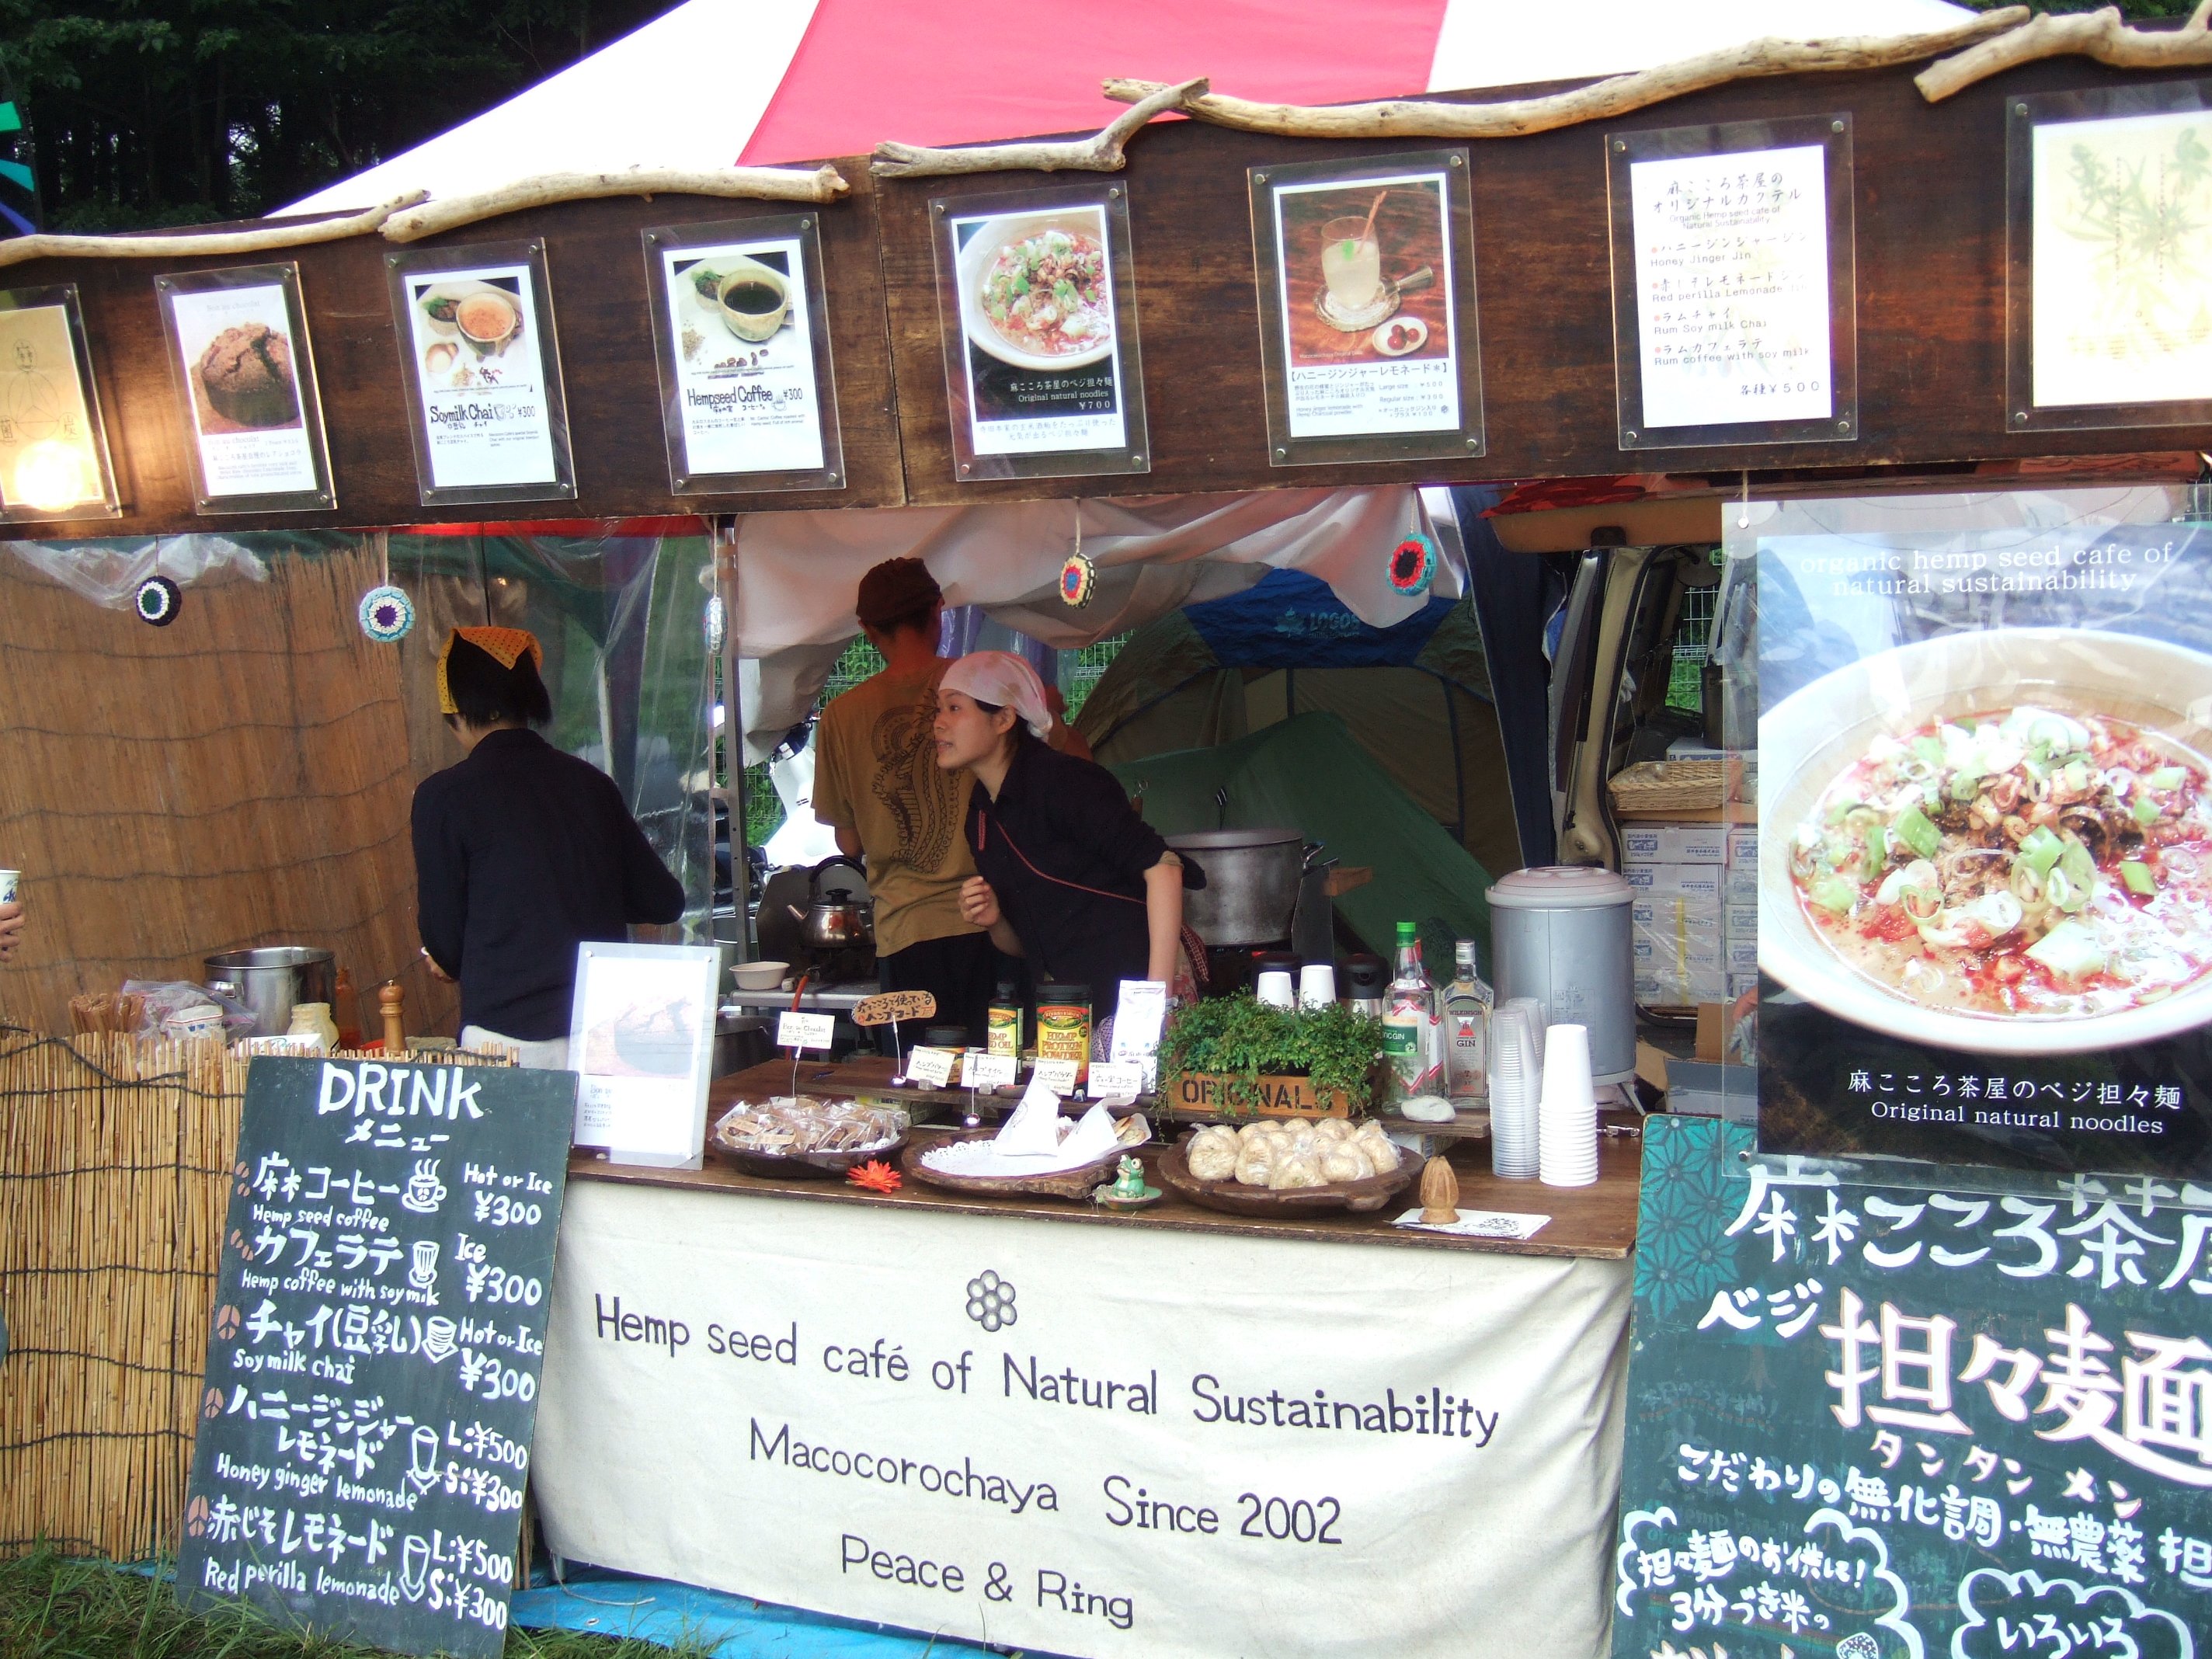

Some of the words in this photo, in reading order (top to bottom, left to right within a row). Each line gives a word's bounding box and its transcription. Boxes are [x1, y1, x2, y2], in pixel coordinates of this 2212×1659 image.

[1653, 189, 1802, 213] オリジナルカクテル
[1667, 172, 1783, 196] 麻こころ茶屋の
[1683, 220, 1713, 230] Natural
[1715, 216, 1771, 228] Sustainability
[1703, 210, 1727, 220] Hemp
[1729, 208, 1749, 217] seed
[1650, 257, 1684, 267] Honey
[1690, 254, 1726, 264] Jinger
[1732, 251, 1751, 260] Jin
[1652, 293, 1673, 302] Red
[1678, 289, 1720, 301] perilla
[1726, 286, 1783, 297] Lemonade
[1654, 325, 1678, 335] Rum
[1683, 324, 1704, 334] Soy
[1708, 321, 1735, 332] milk
[1740, 319, 1767, 329] Chai
[1662, 307, 1731, 322] ラムチャイ
[1654, 356, 1678, 365] Rum
[1683, 352, 1722, 363] coffee
[1727, 350, 1754, 361] with
[1758, 350, 1778, 360] soy
[1782, 347, 1810, 357] milk
[1663, 337, 1763, 355] ラムカフェラテ
[687, 386, 737, 409] Hempseed
[738, 384, 774, 402] Coffee
[1010, 377, 1113, 391] 麻こころ茶屋のベジ担々麺
[1018, 393, 1049, 402] Original
[1051, 391, 1077, 400] natural
[1080, 390, 1109, 398] noodles
[430, 404, 468, 424] Soymilk
[468, 403, 494, 420] Chai
[1079, 401, 1111, 410] ¥700
[1800, 552, 1901, 576] organic
[1913, 550, 1988, 574] hemp
[1998, 546, 2061, 567] seed
[2073, 543, 2132, 565] cafe
[2144, 542, 2172, 563] of
[1833, 572, 1930, 597] natural
[1942, 569, 2137, 595] sustainability
[1047, 1031, 1077, 1041] HEMP
[318, 1062, 485, 1120] DRINK
[1847, 1069, 2181, 1111] 麻こころ茶屋のベジ担々麺
[1870, 1101, 1964, 1123] Original
[1974, 1105, 2060, 1129] natural
[2070, 1112, 2163, 1134] noodles
[344, 1118, 450, 1152] メニュー
[252, 1151, 401, 1202] 麻コーヒー
[463, 1163, 496, 1186] Hot
[503, 1173, 523, 1187] or
[527, 1170, 553, 1195] Ice
[252, 1204, 292, 1226] Hemp
[297, 1204, 333, 1229] seed
[336, 1209, 390, 1232] coffee
[474, 1190, 542, 1226] ¥300
[253, 1225, 405, 1276] カフェラテ
[454, 1233, 487, 1264] Ice
[242, 1268, 279, 1292] Hemp
[283, 1268, 337, 1295] coffee
[340, 1278, 376, 1300] with
[380, 1285, 405, 1305] soy
[465, 1263, 542, 1306] ¥300
[459, 1317, 495, 1344] Hot
[496, 1331, 516, 1347] or
[515, 1325, 544, 1356] Ice
[233, 1349, 264, 1372] Soy
[267, 1350, 306, 1372] milk
[311, 1355, 356, 1385] chai
[459, 1348, 536, 1402] ¥300
[595, 1293, 690, 1358] Hemp
[707, 1322, 798, 1366] seed
[823, 1338, 909, 1382] café
[931, 1350, 973, 1394] of
[1003, 1352, 1157, 1415] Natural
[1191, 1373, 1500, 1448] Sustainability
[1818, 1285, 2212, 1487] 担々麺
[227, 1384, 414, 1440] ハニージンジャー
[278, 1426, 384, 1478] レモネード
[217, 1452, 270, 1487] Honey
[274, 1462, 329, 1497] ginger
[336, 1476, 419, 1511] lemonade
[750, 1417, 1059, 1515] Macocorochaya
[1104, 1475, 1219, 1535] Since
[1237, 1492, 1343, 1545] 2002
[207, 1494, 394, 1564] 赤じそレモネード
[203, 1556, 239, 1595] Red
[245, 1560, 306, 1593] perilla
[316, 1567, 400, 1607] lemonade
[842, 1533, 966, 1593] Peace
[983, 1561, 1013, 1603] &
[1037, 1569, 1134, 1629] Ring
